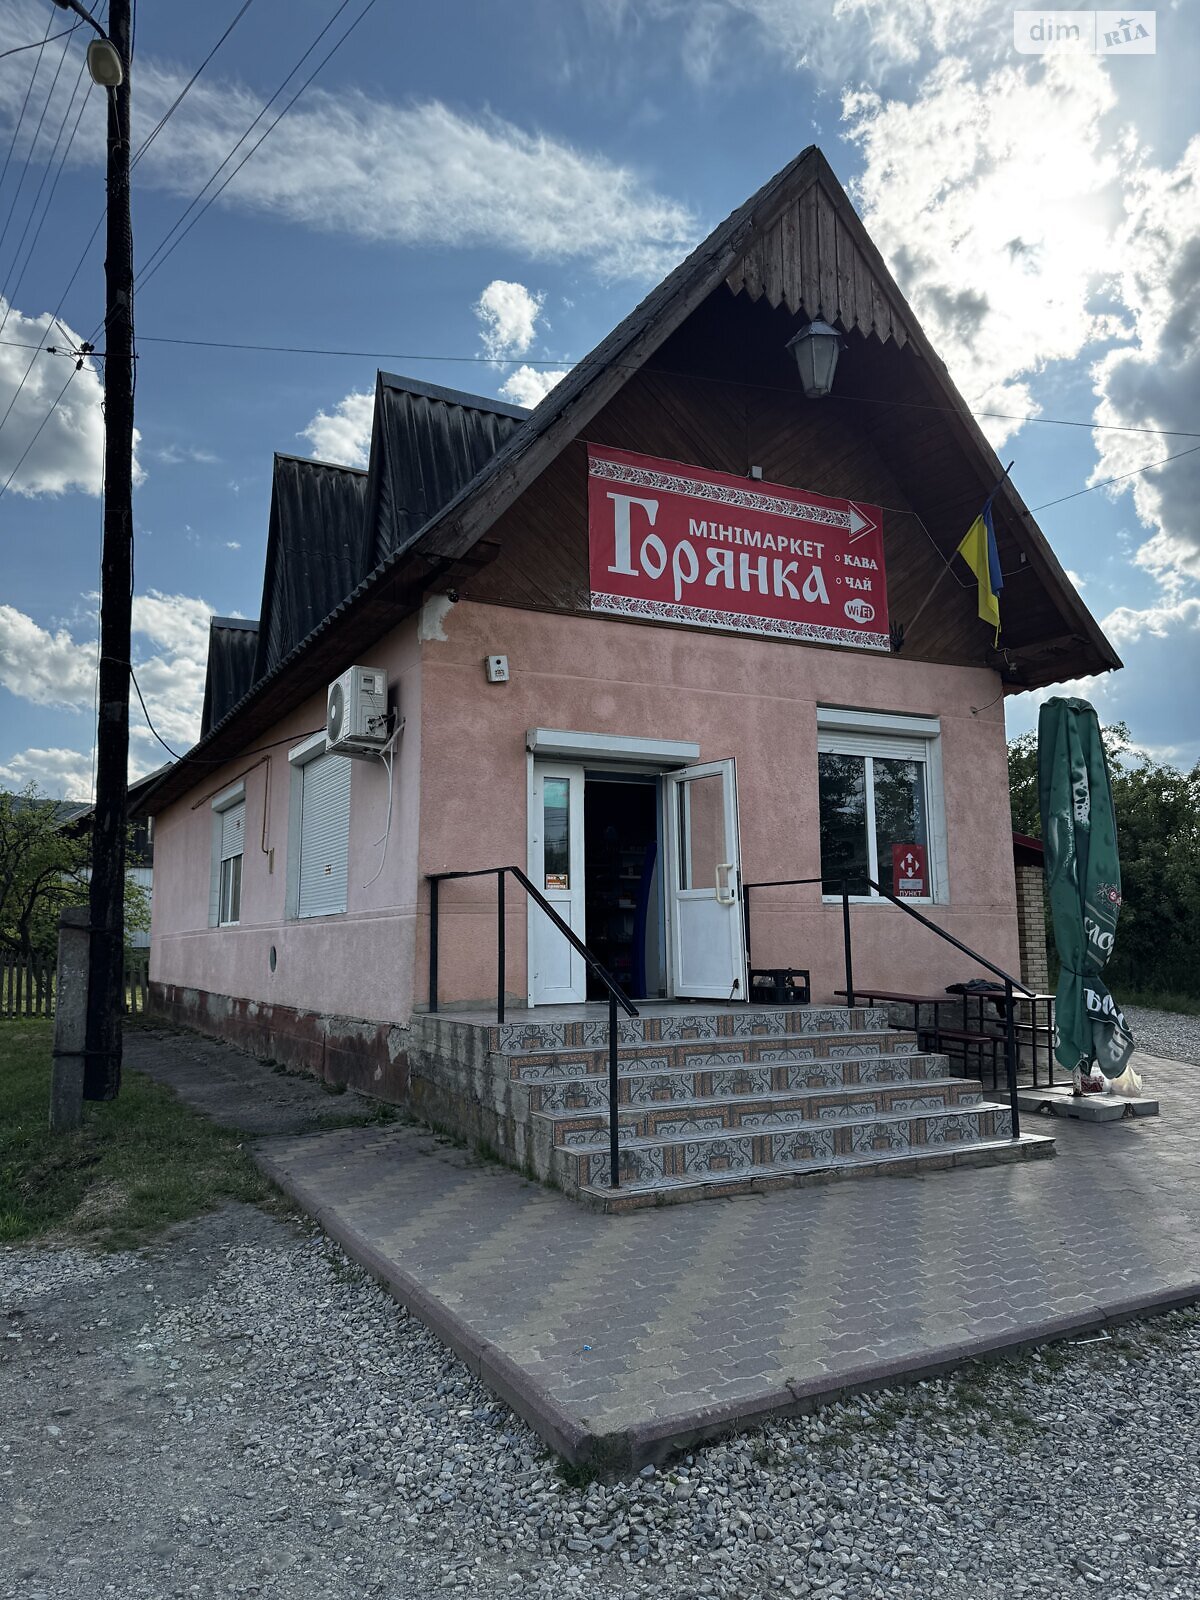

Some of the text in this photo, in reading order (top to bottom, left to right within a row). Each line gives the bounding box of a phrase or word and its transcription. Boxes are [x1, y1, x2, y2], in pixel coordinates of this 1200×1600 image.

[688, 518, 825, 560] МІНІМАРКЕТ
[843, 554, 879, 571] КАВА
[844, 575, 873, 592] ЧАЙ
